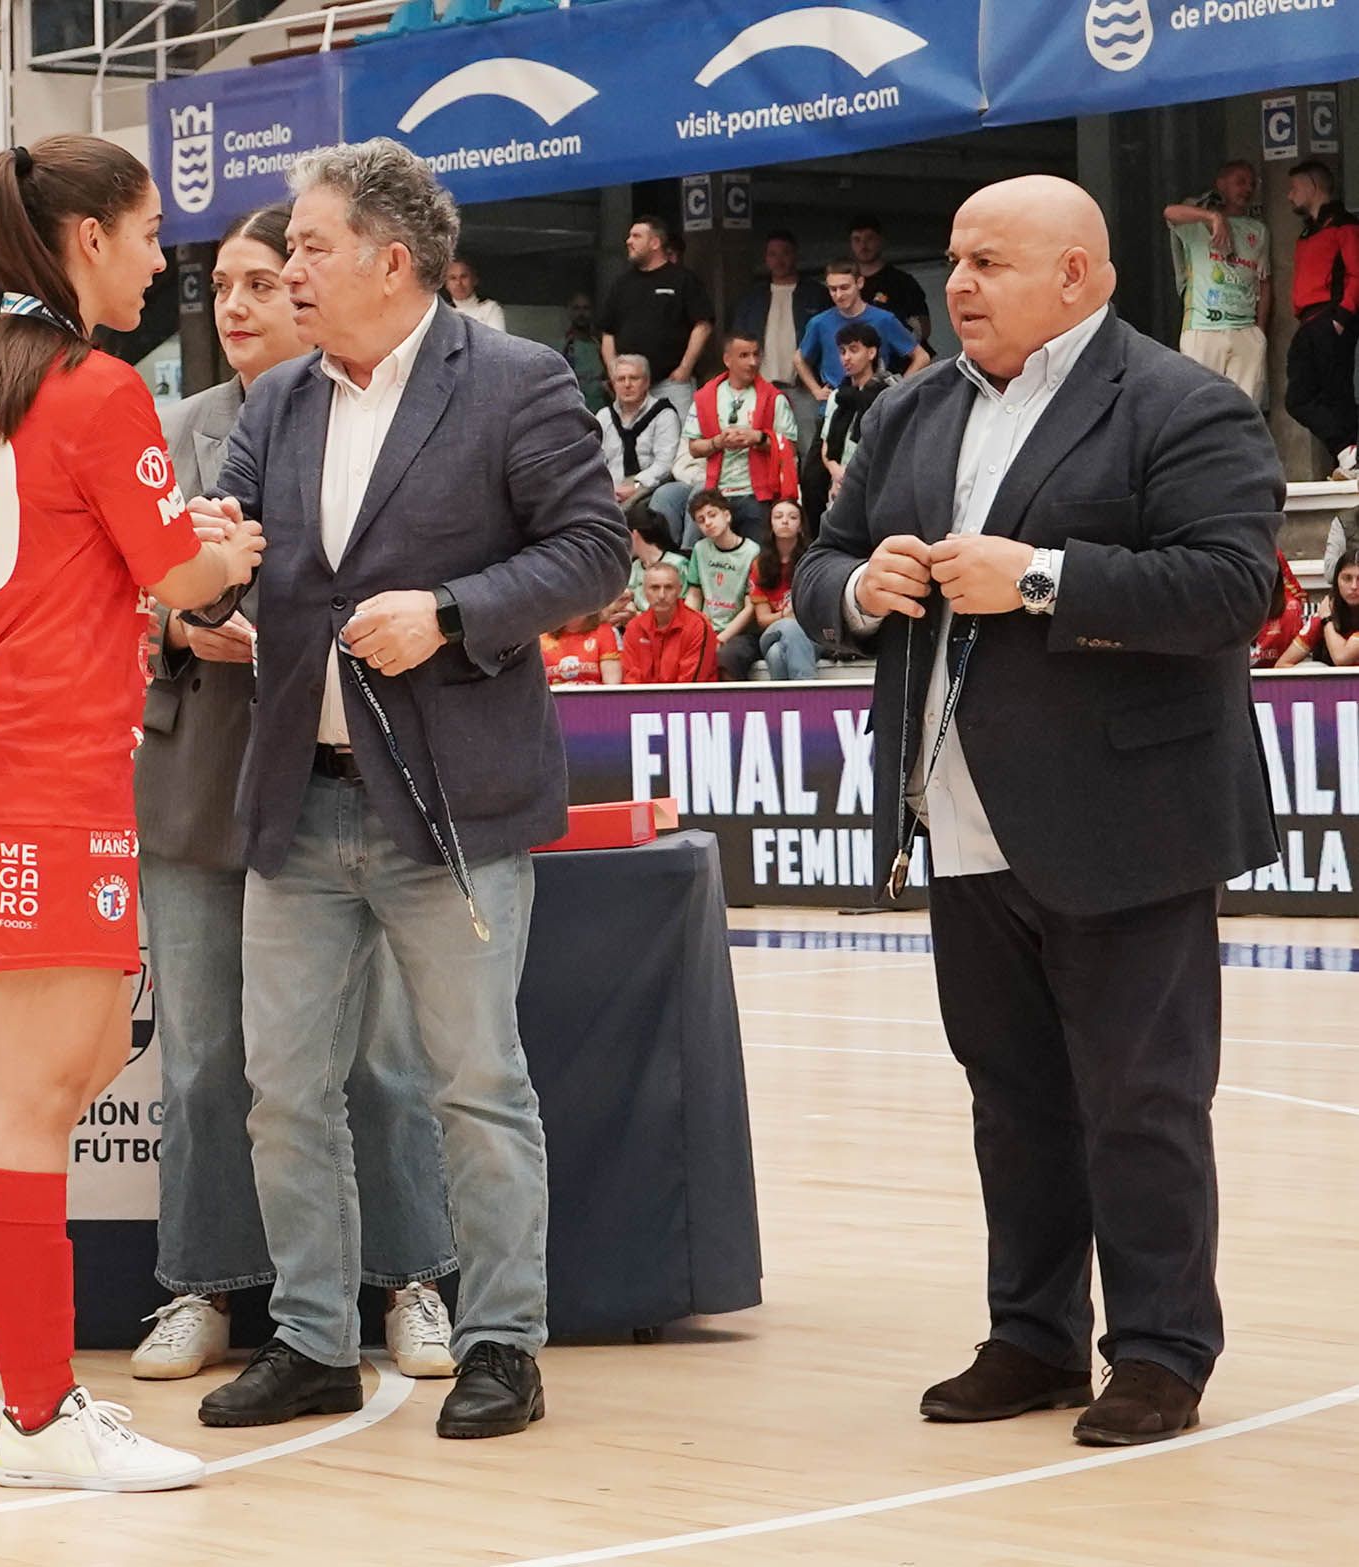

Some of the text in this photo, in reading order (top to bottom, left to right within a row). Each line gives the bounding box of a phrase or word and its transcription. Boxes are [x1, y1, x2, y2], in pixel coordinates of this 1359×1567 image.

[1170, 3, 1201, 31] de
[675, 85, 900, 140] visit-pontevedra.com
[1268, 110, 1291, 143] C
[223, 123, 292, 153] Concello
[223, 157, 244, 180] de
[425, 134, 582, 174] pontevedra.com
[687, 187, 707, 216] C
[630, 709, 818, 816] FINAL
[89, 838, 130, 855] MANS
[0, 918, 32, 930] FOODS
